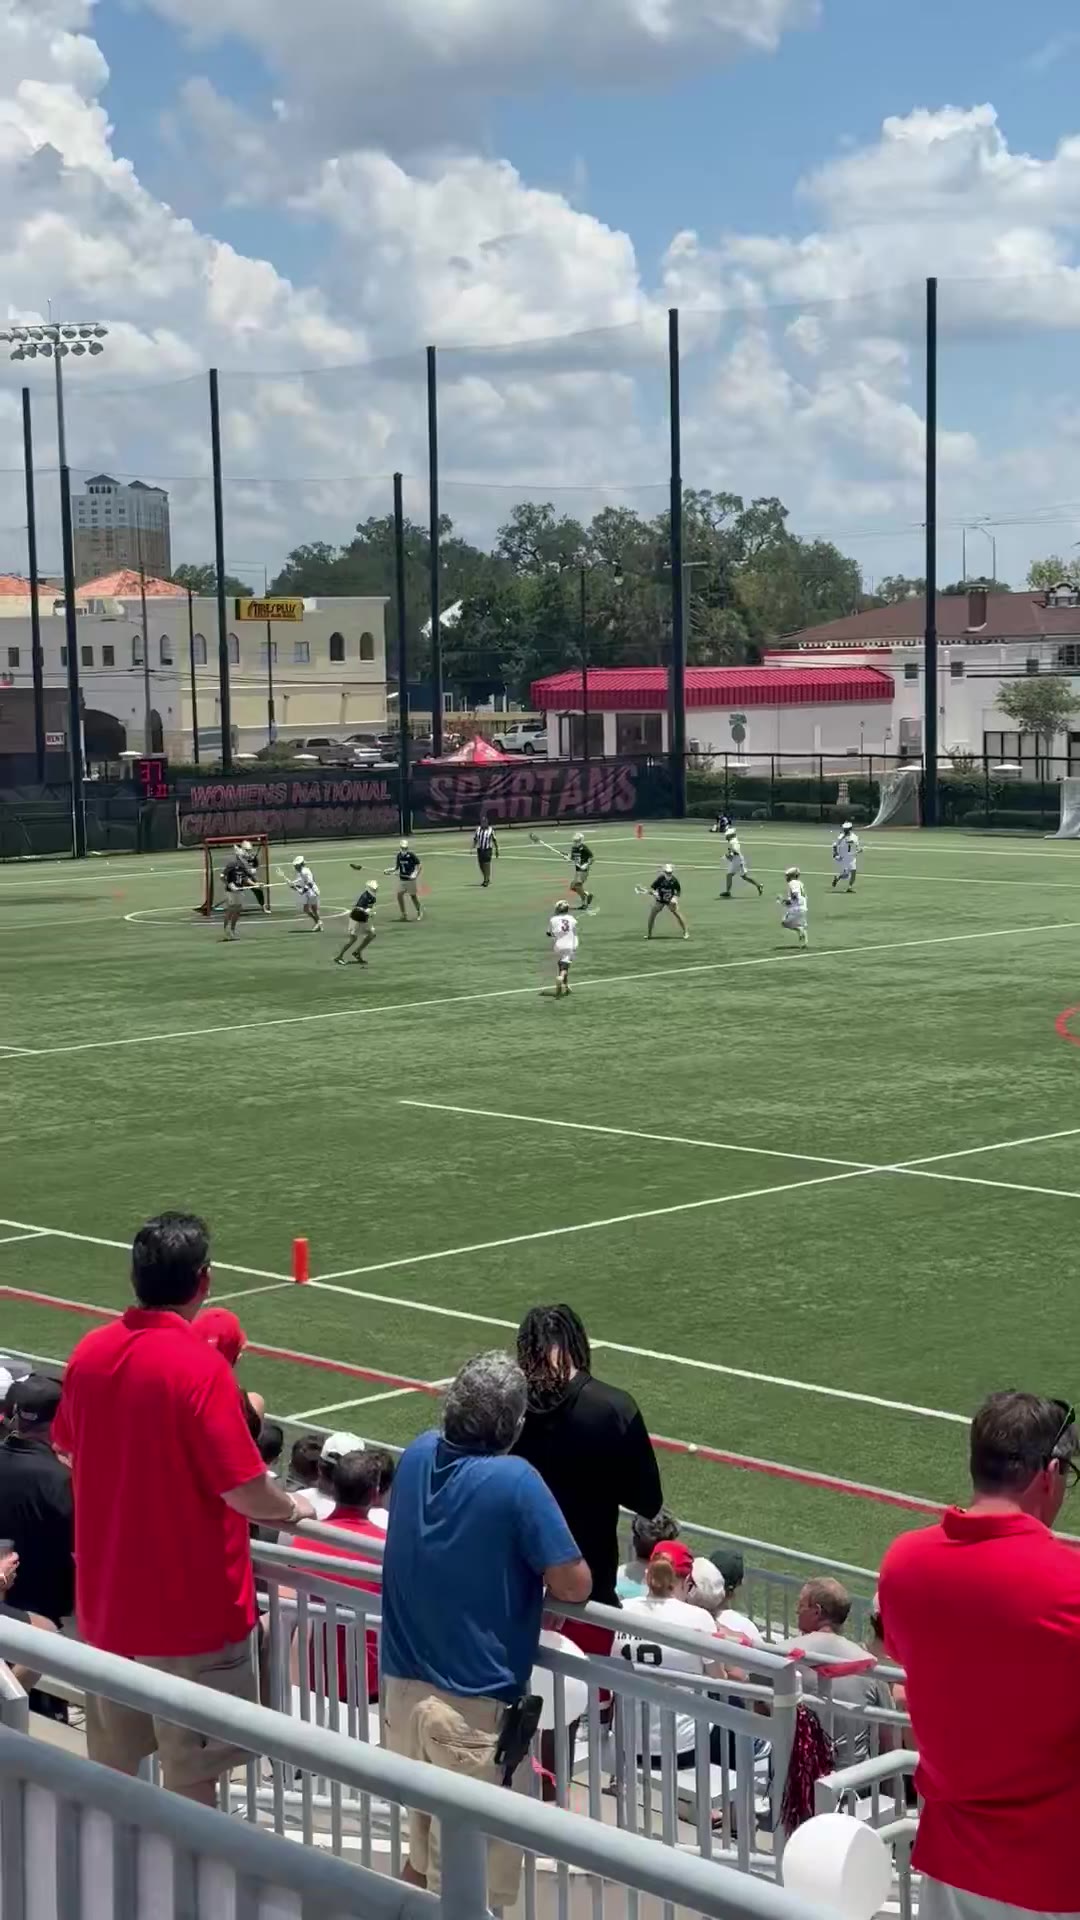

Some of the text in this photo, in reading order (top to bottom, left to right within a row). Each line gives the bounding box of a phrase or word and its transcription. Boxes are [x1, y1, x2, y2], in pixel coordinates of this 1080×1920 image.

[292, 780, 391, 804] NATIONAL
[425, 763, 638, 822] SPARTANS
[561, 919, 570, 932] 3
